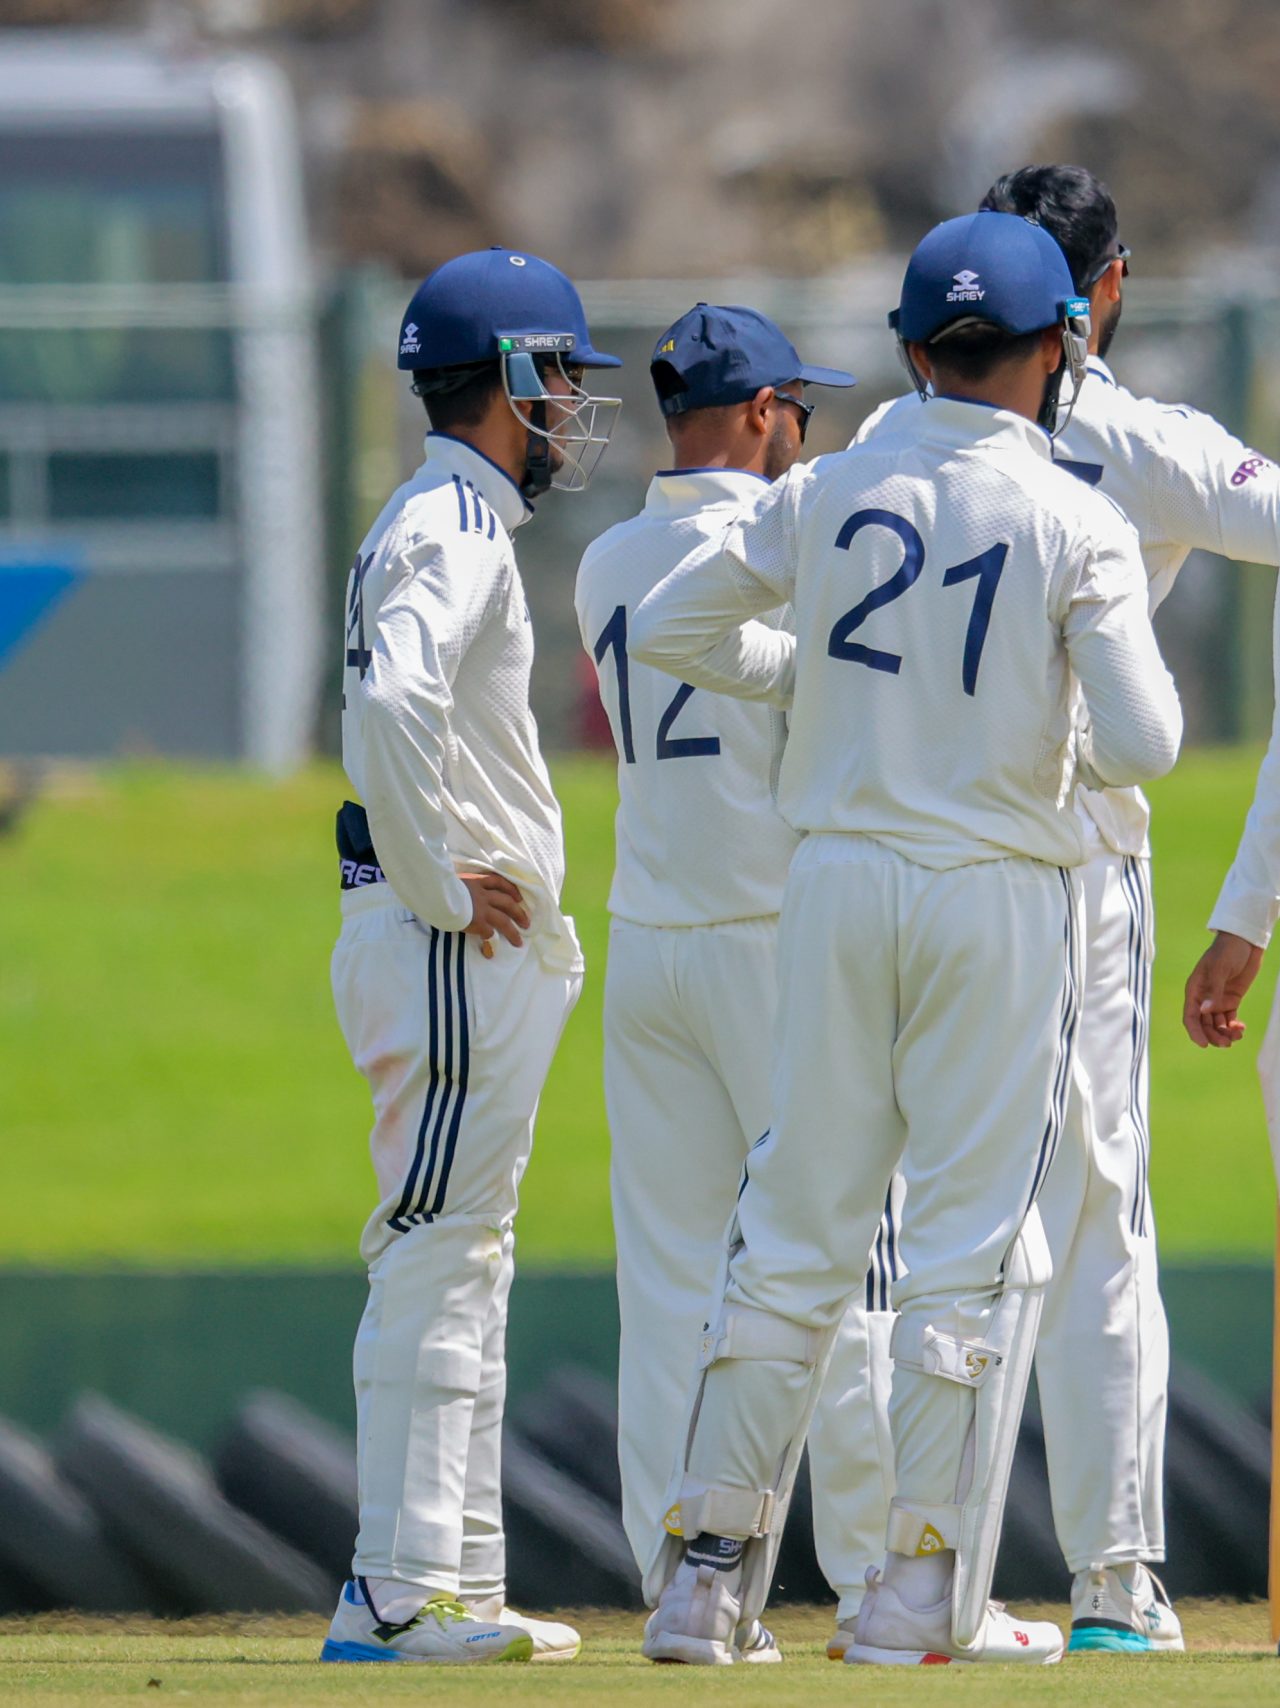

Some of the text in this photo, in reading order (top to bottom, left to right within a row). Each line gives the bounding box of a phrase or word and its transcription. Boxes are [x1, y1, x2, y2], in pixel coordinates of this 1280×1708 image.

[946, 290, 985, 302] SHREY
[525, 336, 560, 347] SHREY
[828, 508, 1009, 697] 21
[465, 1631, 502, 1643] LOTTO
